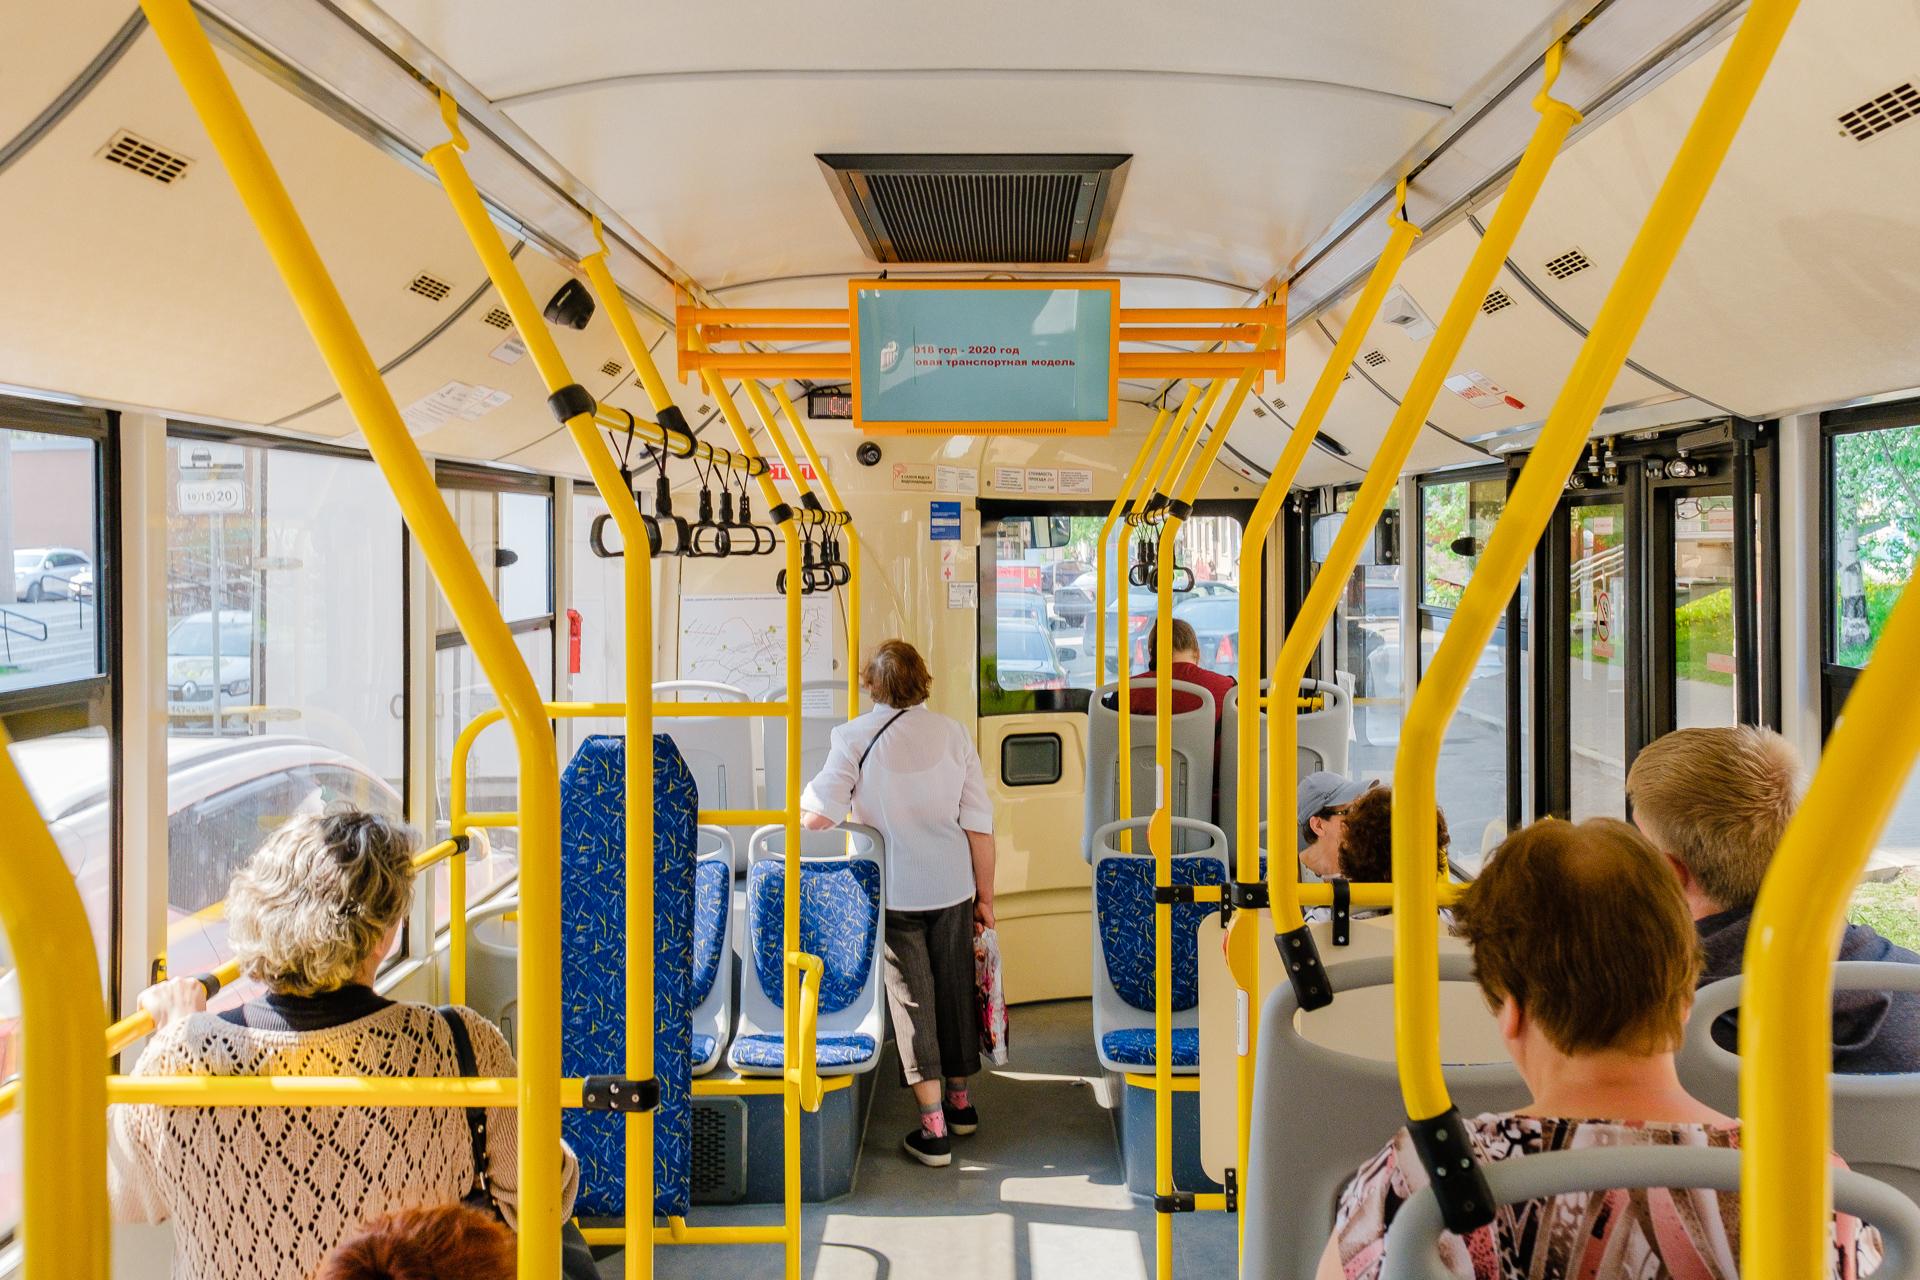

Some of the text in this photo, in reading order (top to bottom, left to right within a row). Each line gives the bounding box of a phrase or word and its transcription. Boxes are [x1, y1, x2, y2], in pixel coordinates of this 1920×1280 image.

[938, 347, 958, 355] год
[968, 346, 996, 354] 2020
[1000, 347, 1020, 355] год
[946, 359, 1028, 368] транспортная
[1031, 359, 1075, 367] модель
[217, 490, 232, 502] 20
